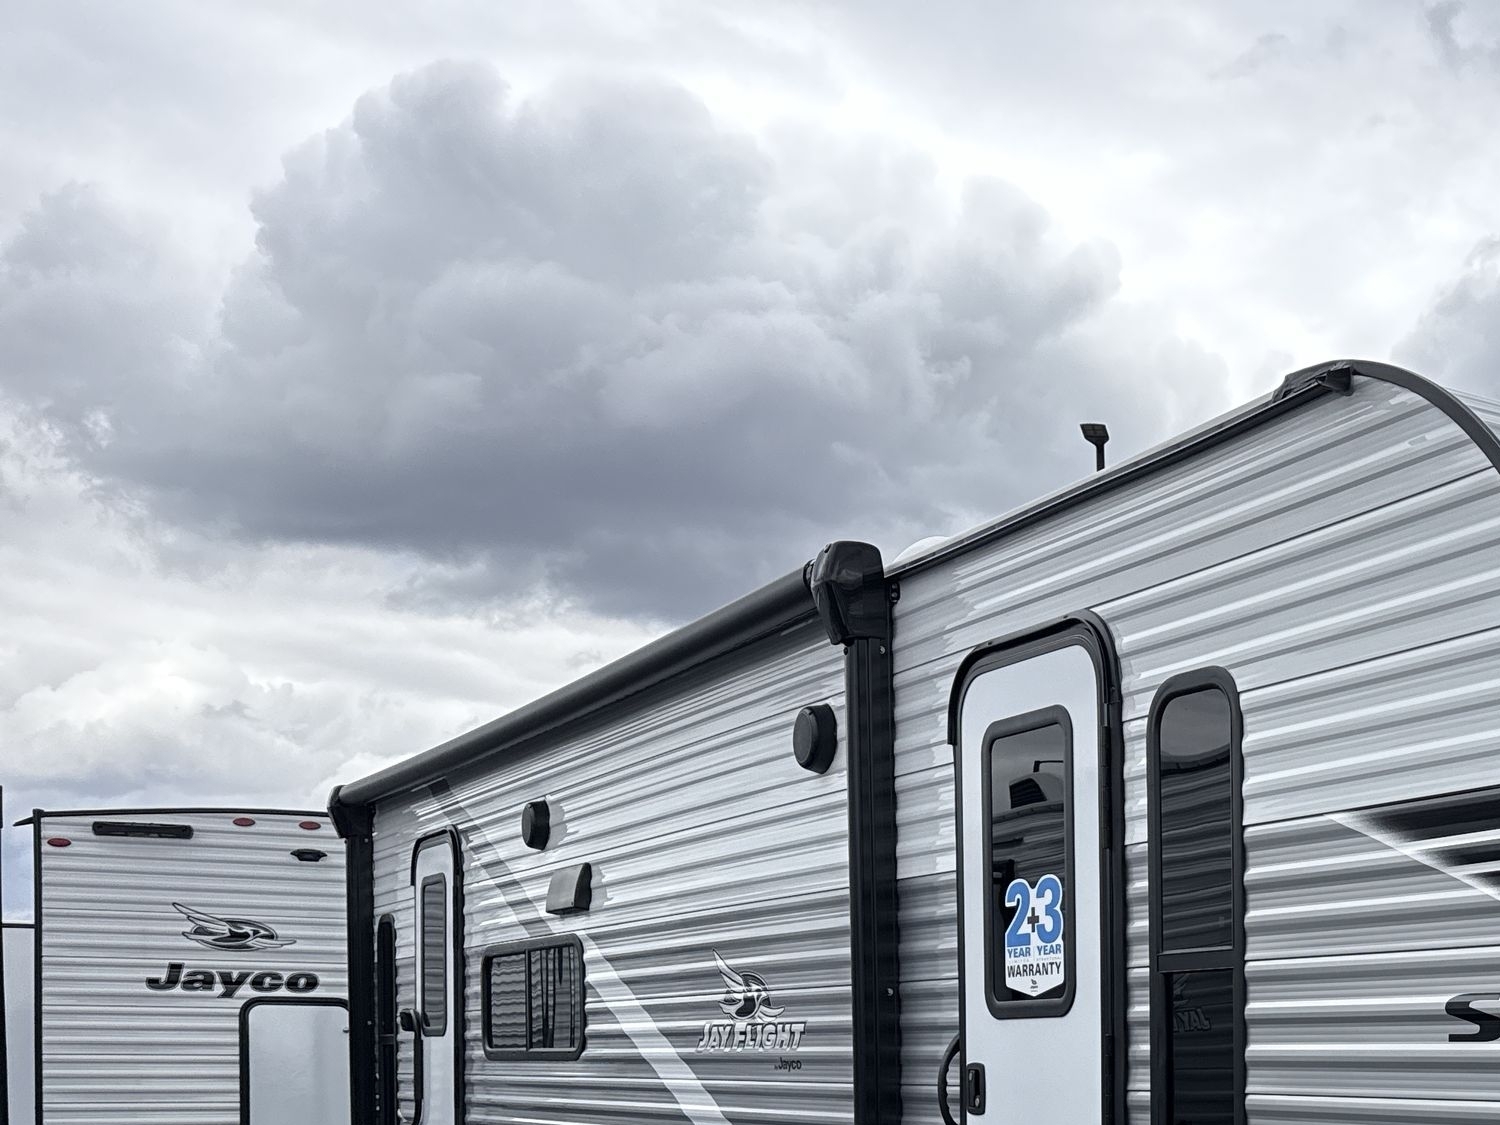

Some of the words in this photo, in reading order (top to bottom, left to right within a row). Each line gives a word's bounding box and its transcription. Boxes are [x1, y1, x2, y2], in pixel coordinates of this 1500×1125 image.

[1007, 947, 1031, 958] YEAR
[1037, 944, 1062, 955] YEAR
[1007, 962, 1062, 978] WARRANTY
[145, 962, 320, 998] Jayco
[696, 1021, 733, 1053] JAY
[731, 1020, 807, 1052] FLIGHT
[778, 1056, 802, 1072] Jayco
